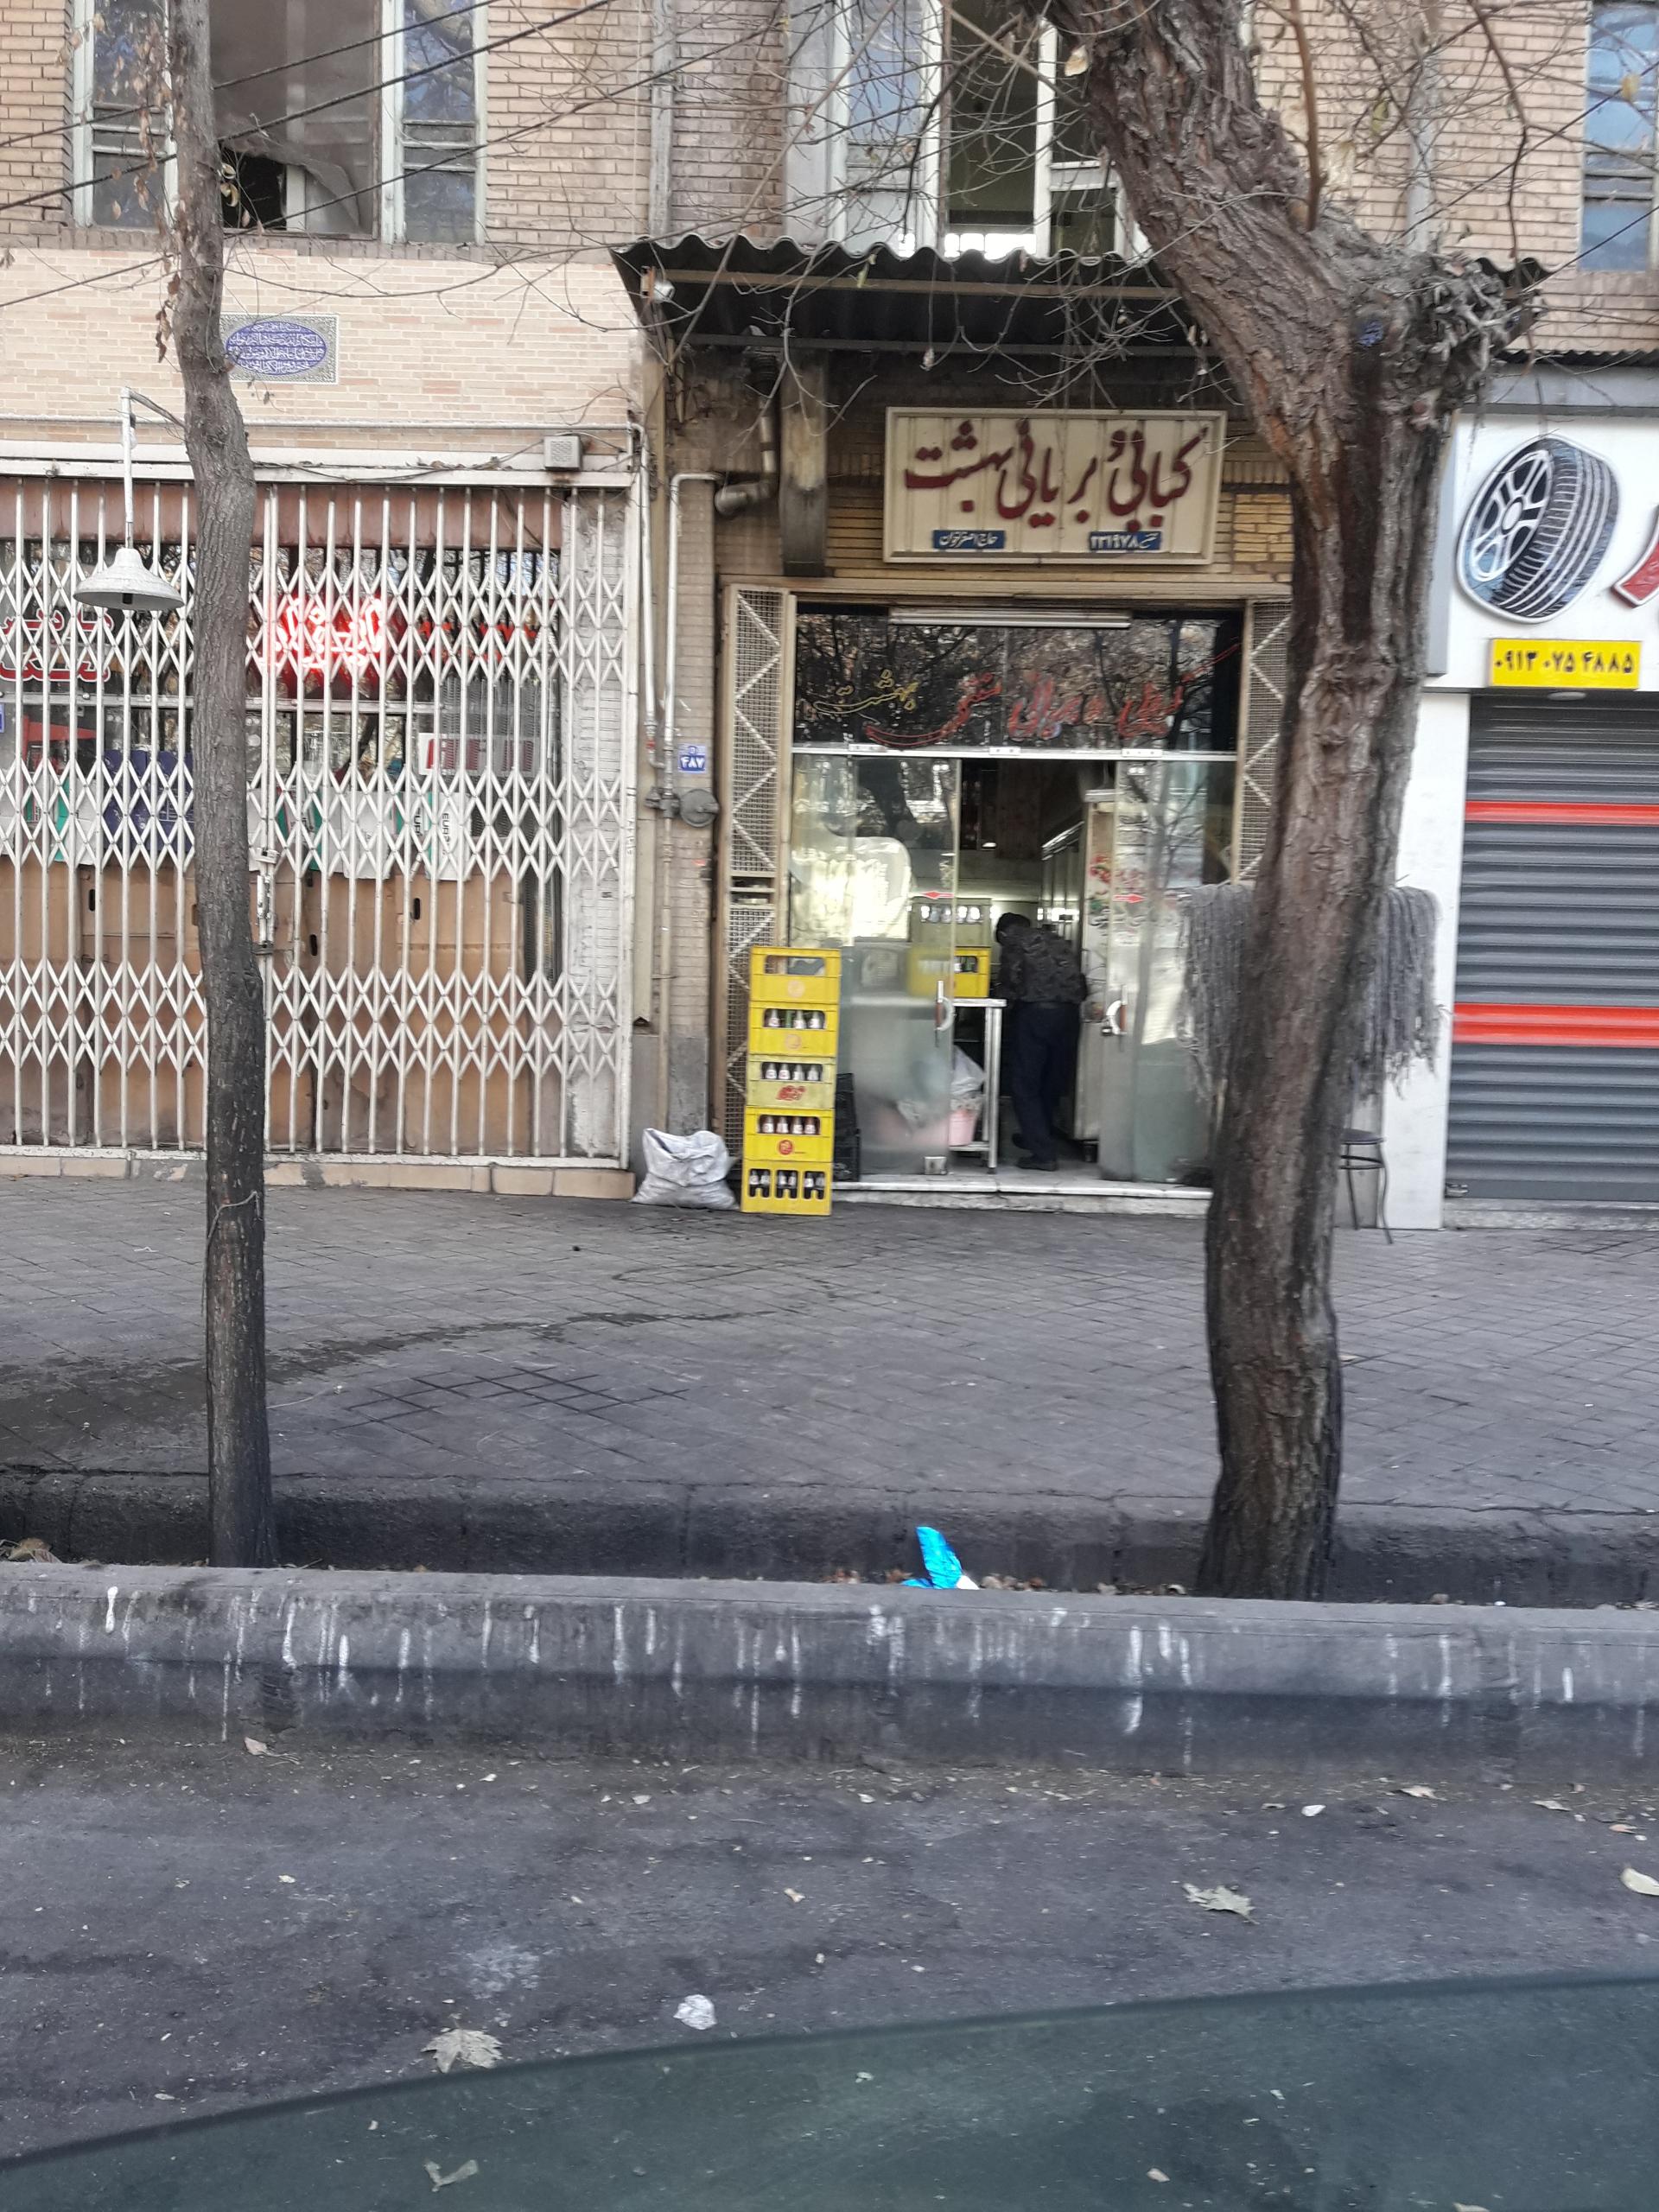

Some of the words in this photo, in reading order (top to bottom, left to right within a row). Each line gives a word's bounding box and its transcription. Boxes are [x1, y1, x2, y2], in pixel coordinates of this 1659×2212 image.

[905, 420, 1014, 513] بهشت
[996, 419, 1097, 528] بریانی
[1109, 425, 1210, 531] کبابی
[1495, 650, 1537, 671] ۰۹۱۳
[1544, 652, 1576, 673] ۰۷۵
[1583, 652, 1634, 674] ۴۸۸۵
